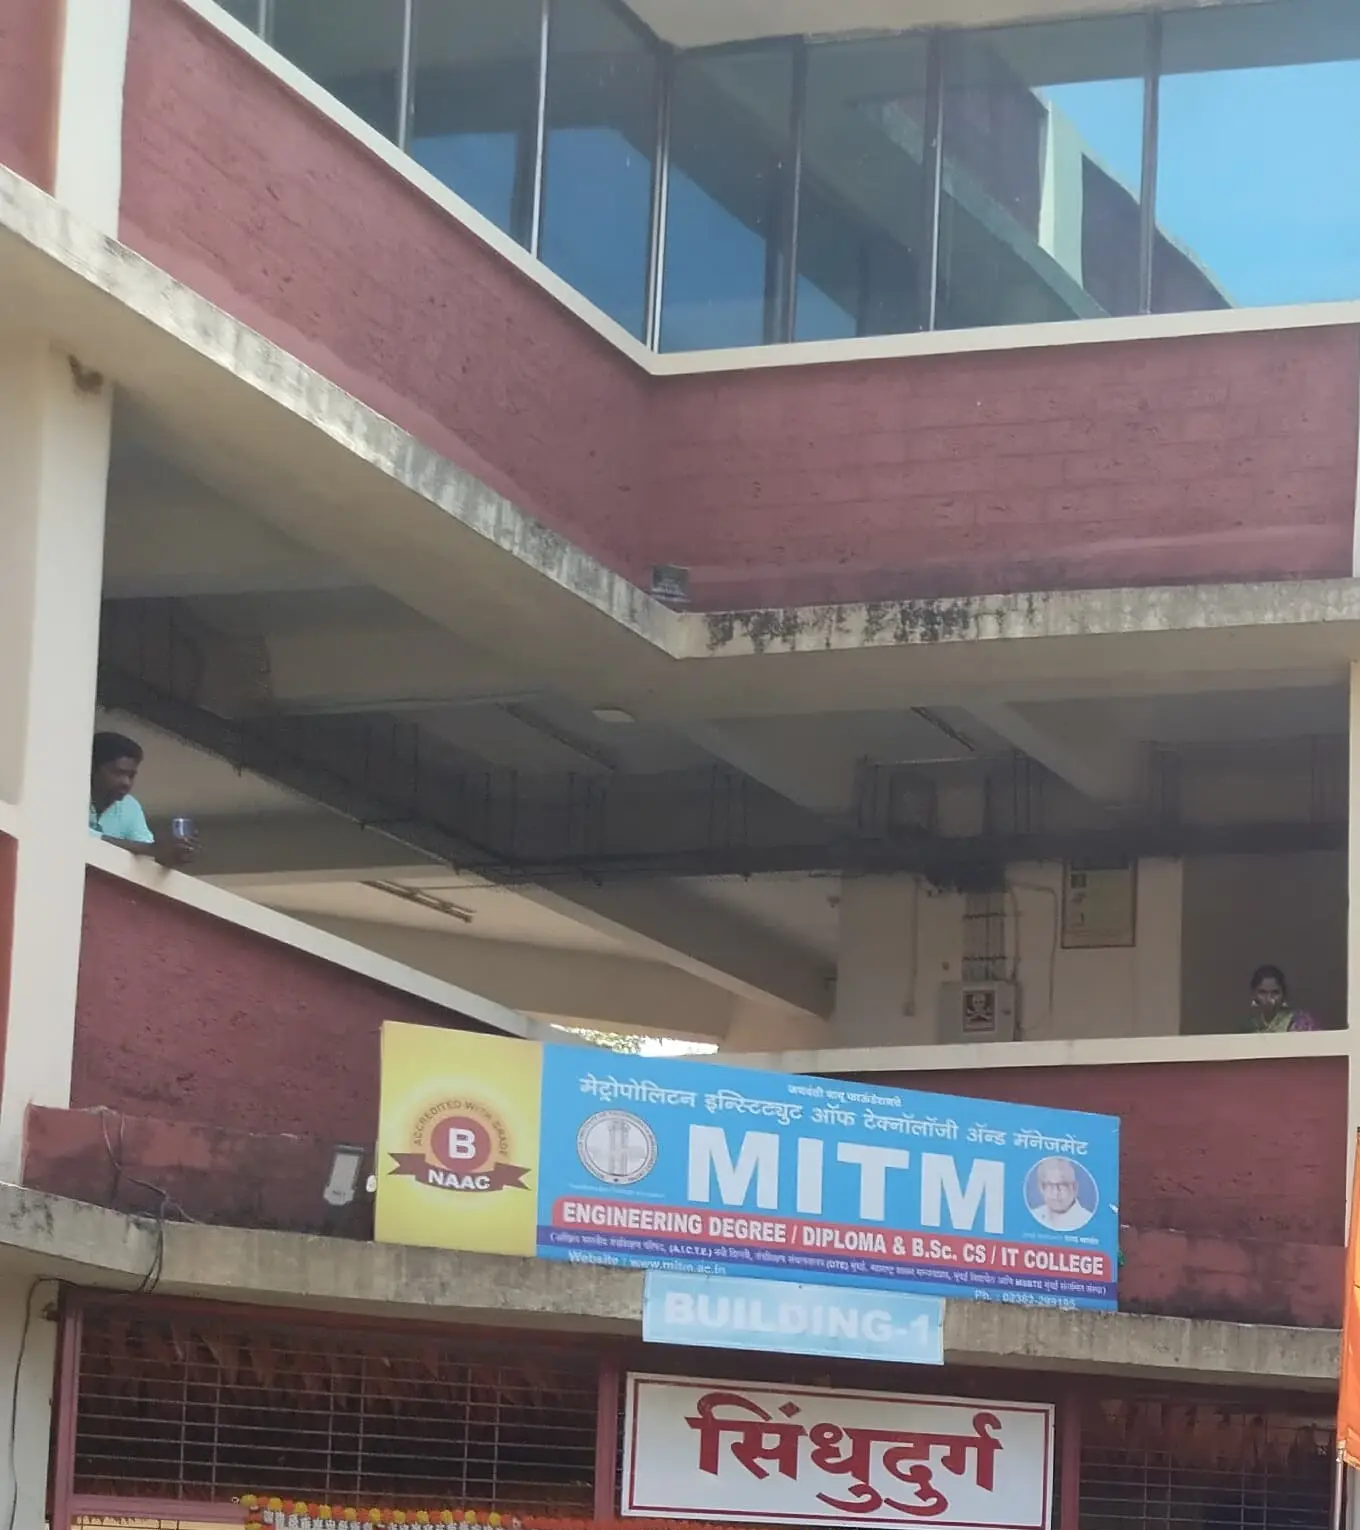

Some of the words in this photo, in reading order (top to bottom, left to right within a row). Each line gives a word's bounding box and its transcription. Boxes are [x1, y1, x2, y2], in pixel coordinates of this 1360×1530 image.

[414, 1100, 462, 1147] ACCREDITED
[465, 1101, 492, 1120] WITH
[578, 1072, 697, 1107] मेट्रोपोलिटन
[811, 1103, 857, 1127] ऑफ
[448, 1127, 476, 1159] B
[428, 1170, 490, 1190] NAAC
[687, 1123, 1005, 1234] MITM
[563, 1201, 703, 1235] ENGINEERING
[709, 1217, 787, 1243] DEGREE
[803, 1226, 888, 1254] DIPLOMA
[892, 1235, 907, 1256] &
[912, 1238, 958, 1261] B.Sc.
[963, 1243, 986, 1264] CS
[1001, 1246, 1020, 1267] IT
[1024, 1249, 1104, 1276] COLLEGE
[664, 1290, 930, 1345] BUILDING-1
[685, 1390, 1004, 1517] सिंधुदुर्ग
